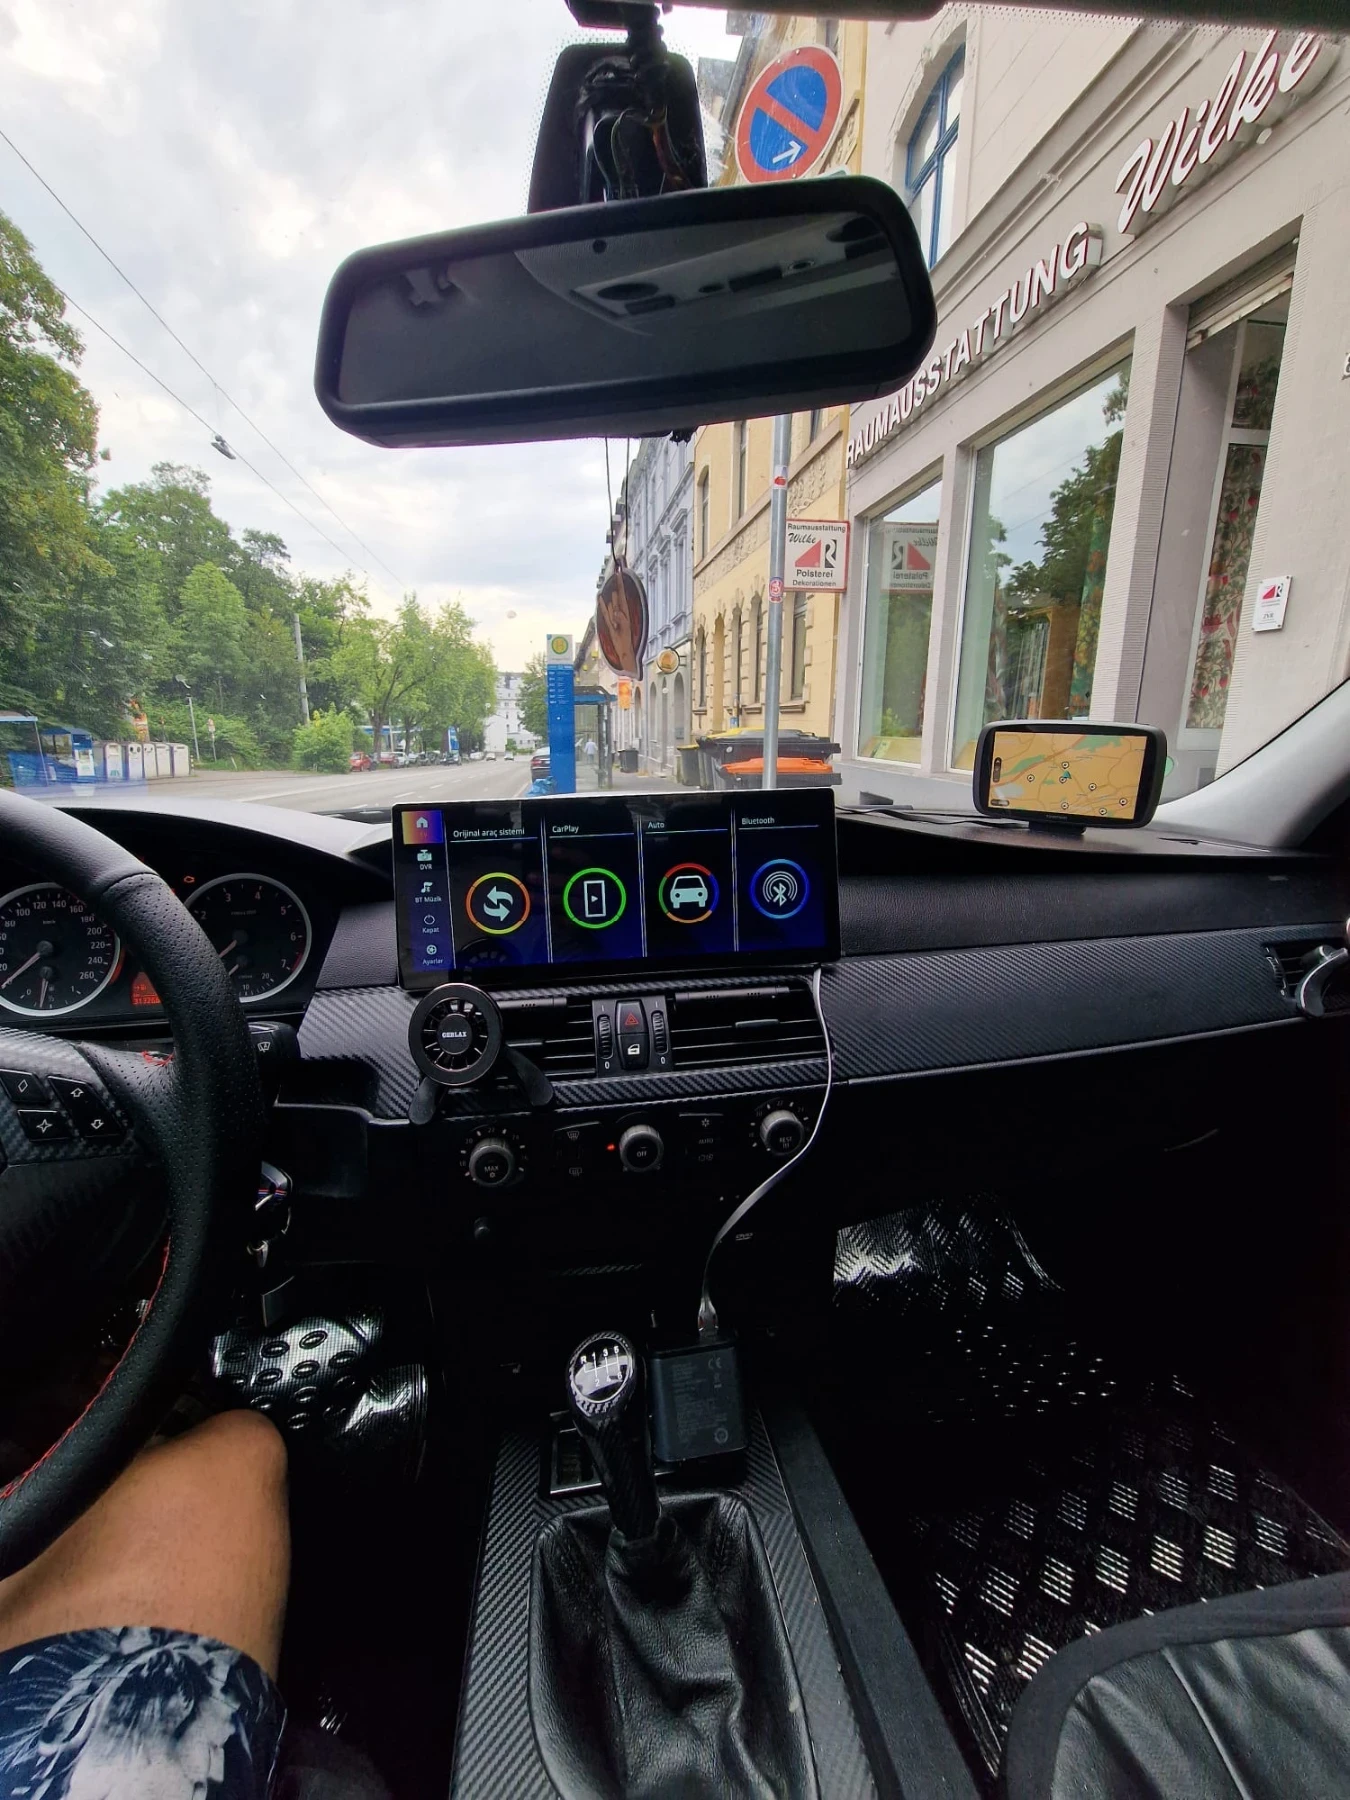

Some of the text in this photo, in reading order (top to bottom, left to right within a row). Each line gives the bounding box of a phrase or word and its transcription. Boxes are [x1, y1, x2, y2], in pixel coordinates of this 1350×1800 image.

[846, 30, 1322, 469] RAUMAUSSTATTUNG Wilke
[787, 522, 846, 533] Raumausstattung
[788, 532, 816, 544] Wilke
[796, 569, 833, 578] Polsterei
[792, 579, 837, 588] Dekorationen
[648, 821, 665, 829] Auto
[741, 816, 775, 825] Bluetooth
[453, 828, 525, 839] Orijinal araç sistemi
[552, 825, 579, 835] CarPlay
[33, 901, 47, 910] 120
[52, 900, 67, 908] 140
[16, 908, 31, 917] 100
[69, 905, 84, 914] 160
[87, 927, 102, 936] 200
[290, 932, 297, 941] 6
[88, 956, 103, 965] 240
[281, 959, 287, 968] 7
[422, 958, 444, 966] Ayarlar
[79, 971, 95, 980] 260
[261, 972, 270, 980] 20
[243, 983, 250, 991] 10
[580, 1356, 587, 1364] R
[595, 1379, 600, 1387] 2
